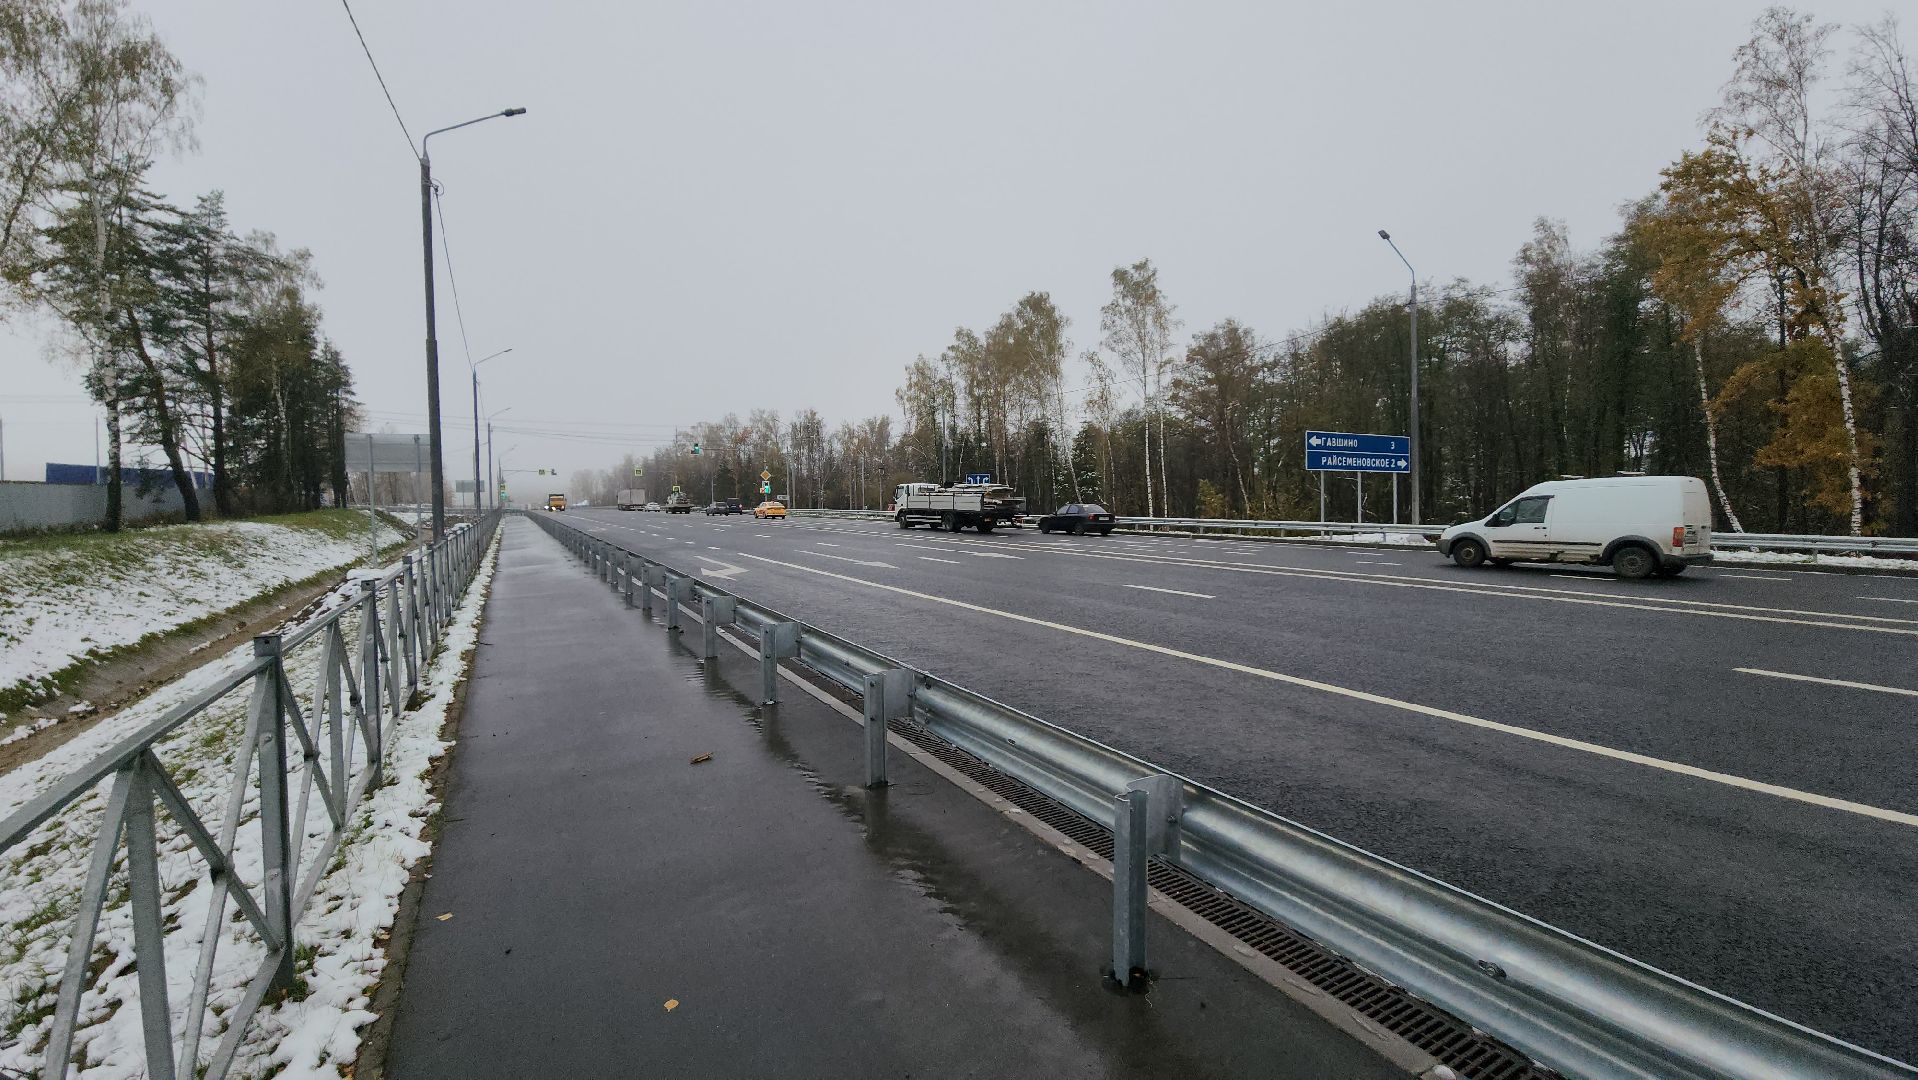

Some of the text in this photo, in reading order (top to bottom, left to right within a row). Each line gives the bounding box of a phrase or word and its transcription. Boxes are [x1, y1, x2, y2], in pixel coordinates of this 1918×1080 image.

[1321, 437, 1395, 450] ГАВШИНО 3
[1321, 455, 1396, 468] РАЙСЕМЕНОВСКОЕ 2
